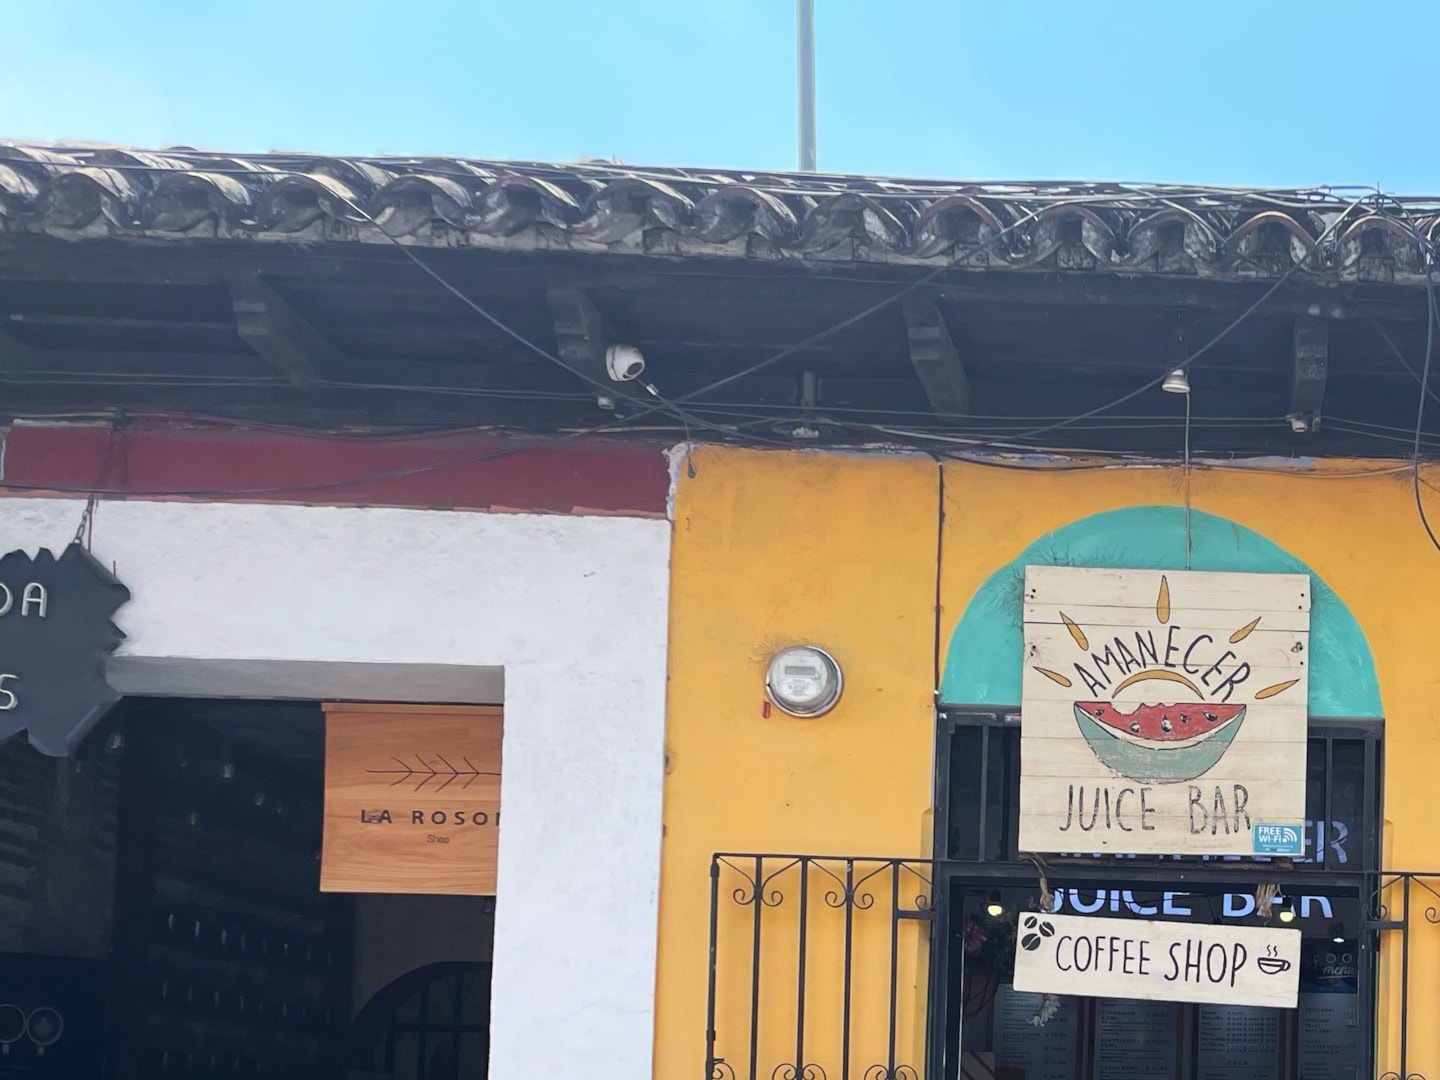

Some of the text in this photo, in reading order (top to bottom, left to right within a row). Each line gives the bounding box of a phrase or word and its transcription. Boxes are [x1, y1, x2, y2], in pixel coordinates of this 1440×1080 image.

[1073, 626, 1251, 702] AMANECER
[361, 809, 500, 826] LA ROSO
[1058, 784, 1252, 836] JUICE BAR
[1258, 827, 1282, 835] FREE
[1258, 835, 1282, 843] WI-FI
[1056, 935, 1248, 987] COFFEE SHOP
